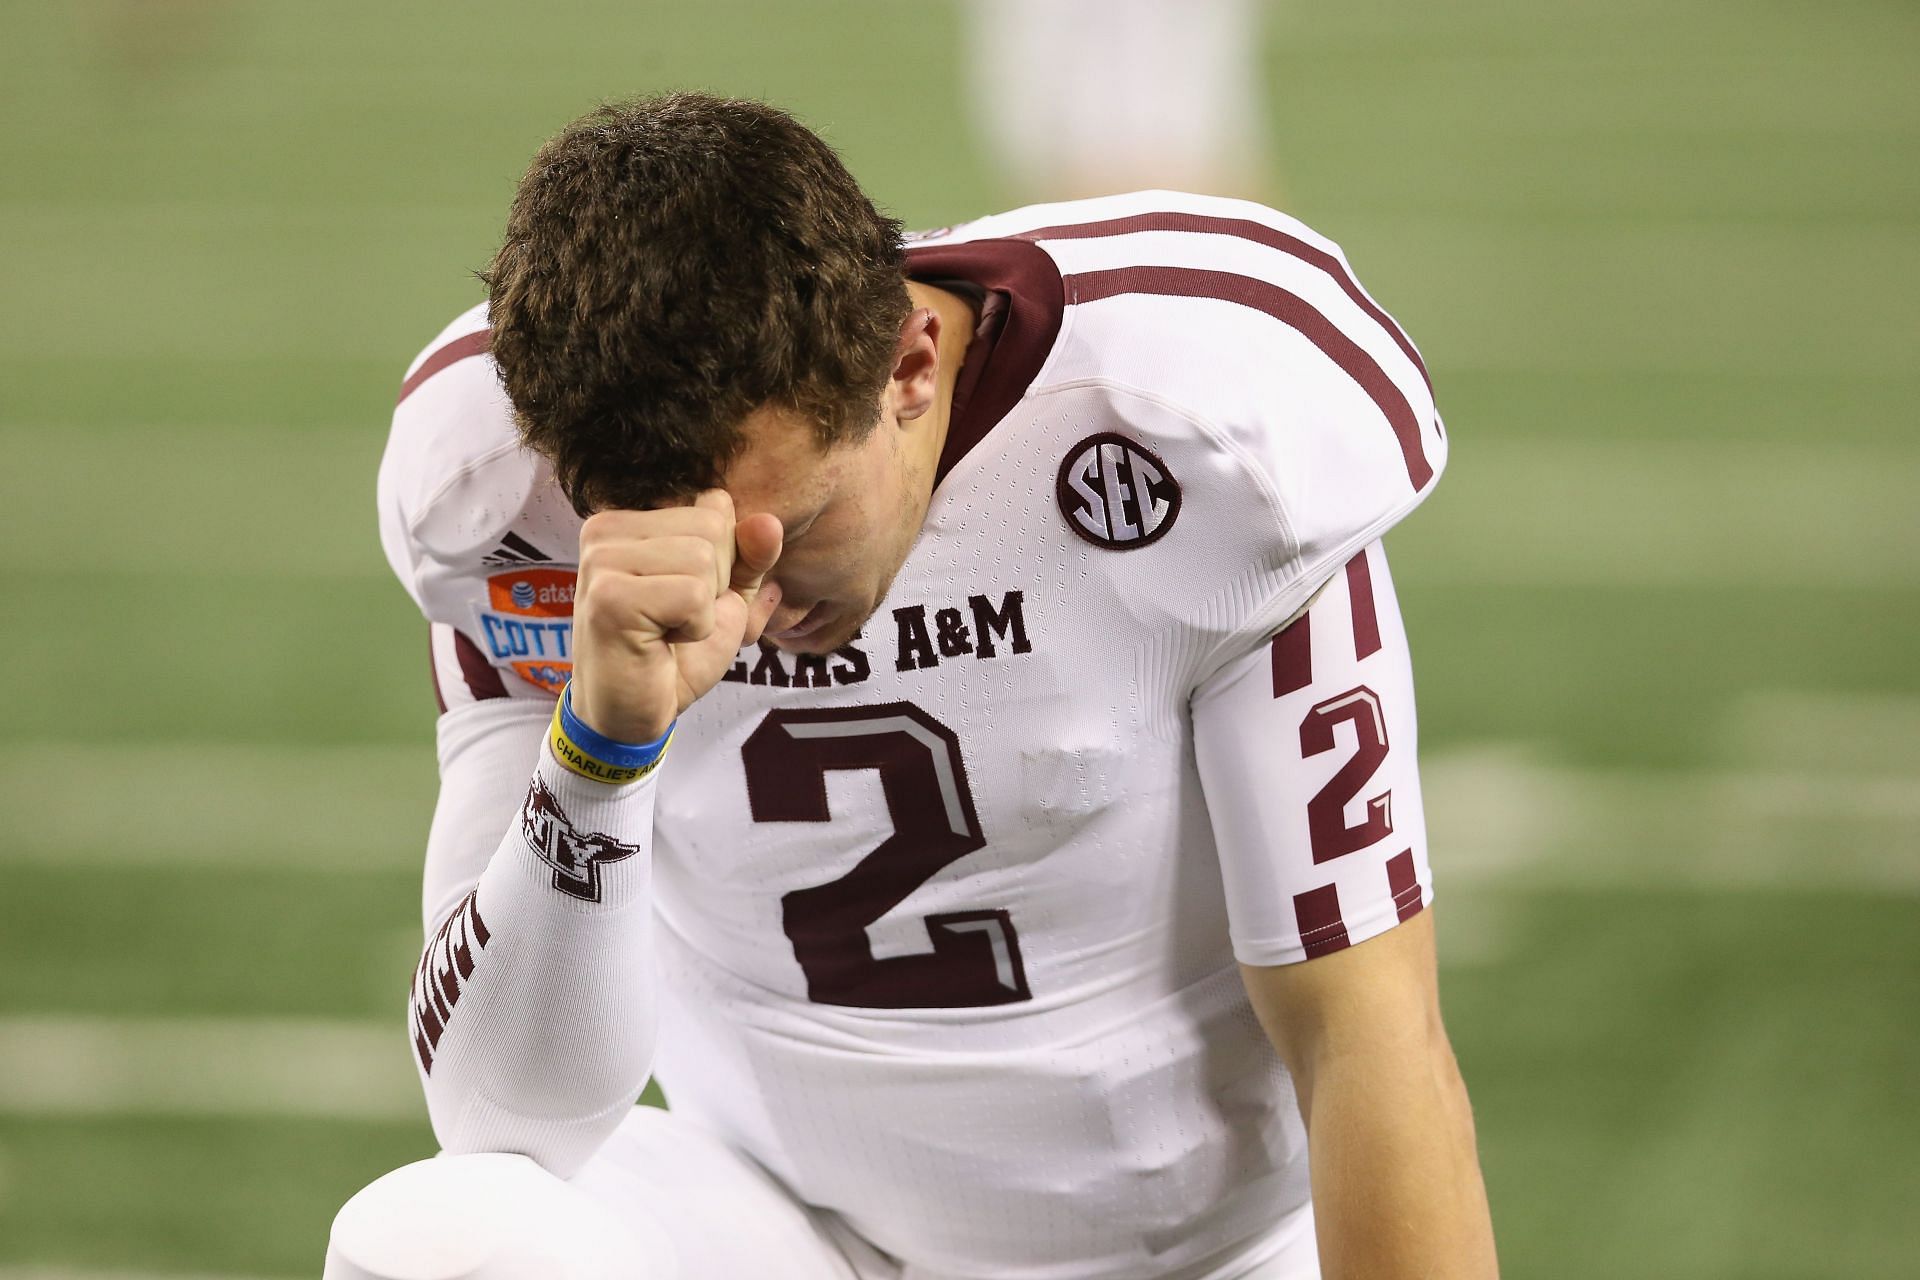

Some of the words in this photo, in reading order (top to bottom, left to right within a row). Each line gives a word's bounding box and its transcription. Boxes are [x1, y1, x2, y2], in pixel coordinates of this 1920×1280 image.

[1068, 443, 1170, 541] SEC
[481, 614, 573, 658] COTT
[892, 590, 1032, 672] A&M
[557, 737, 638, 780] CHARLIE'S
[1299, 684, 1394, 866] 2
[741, 700, 1033, 1009] 2
